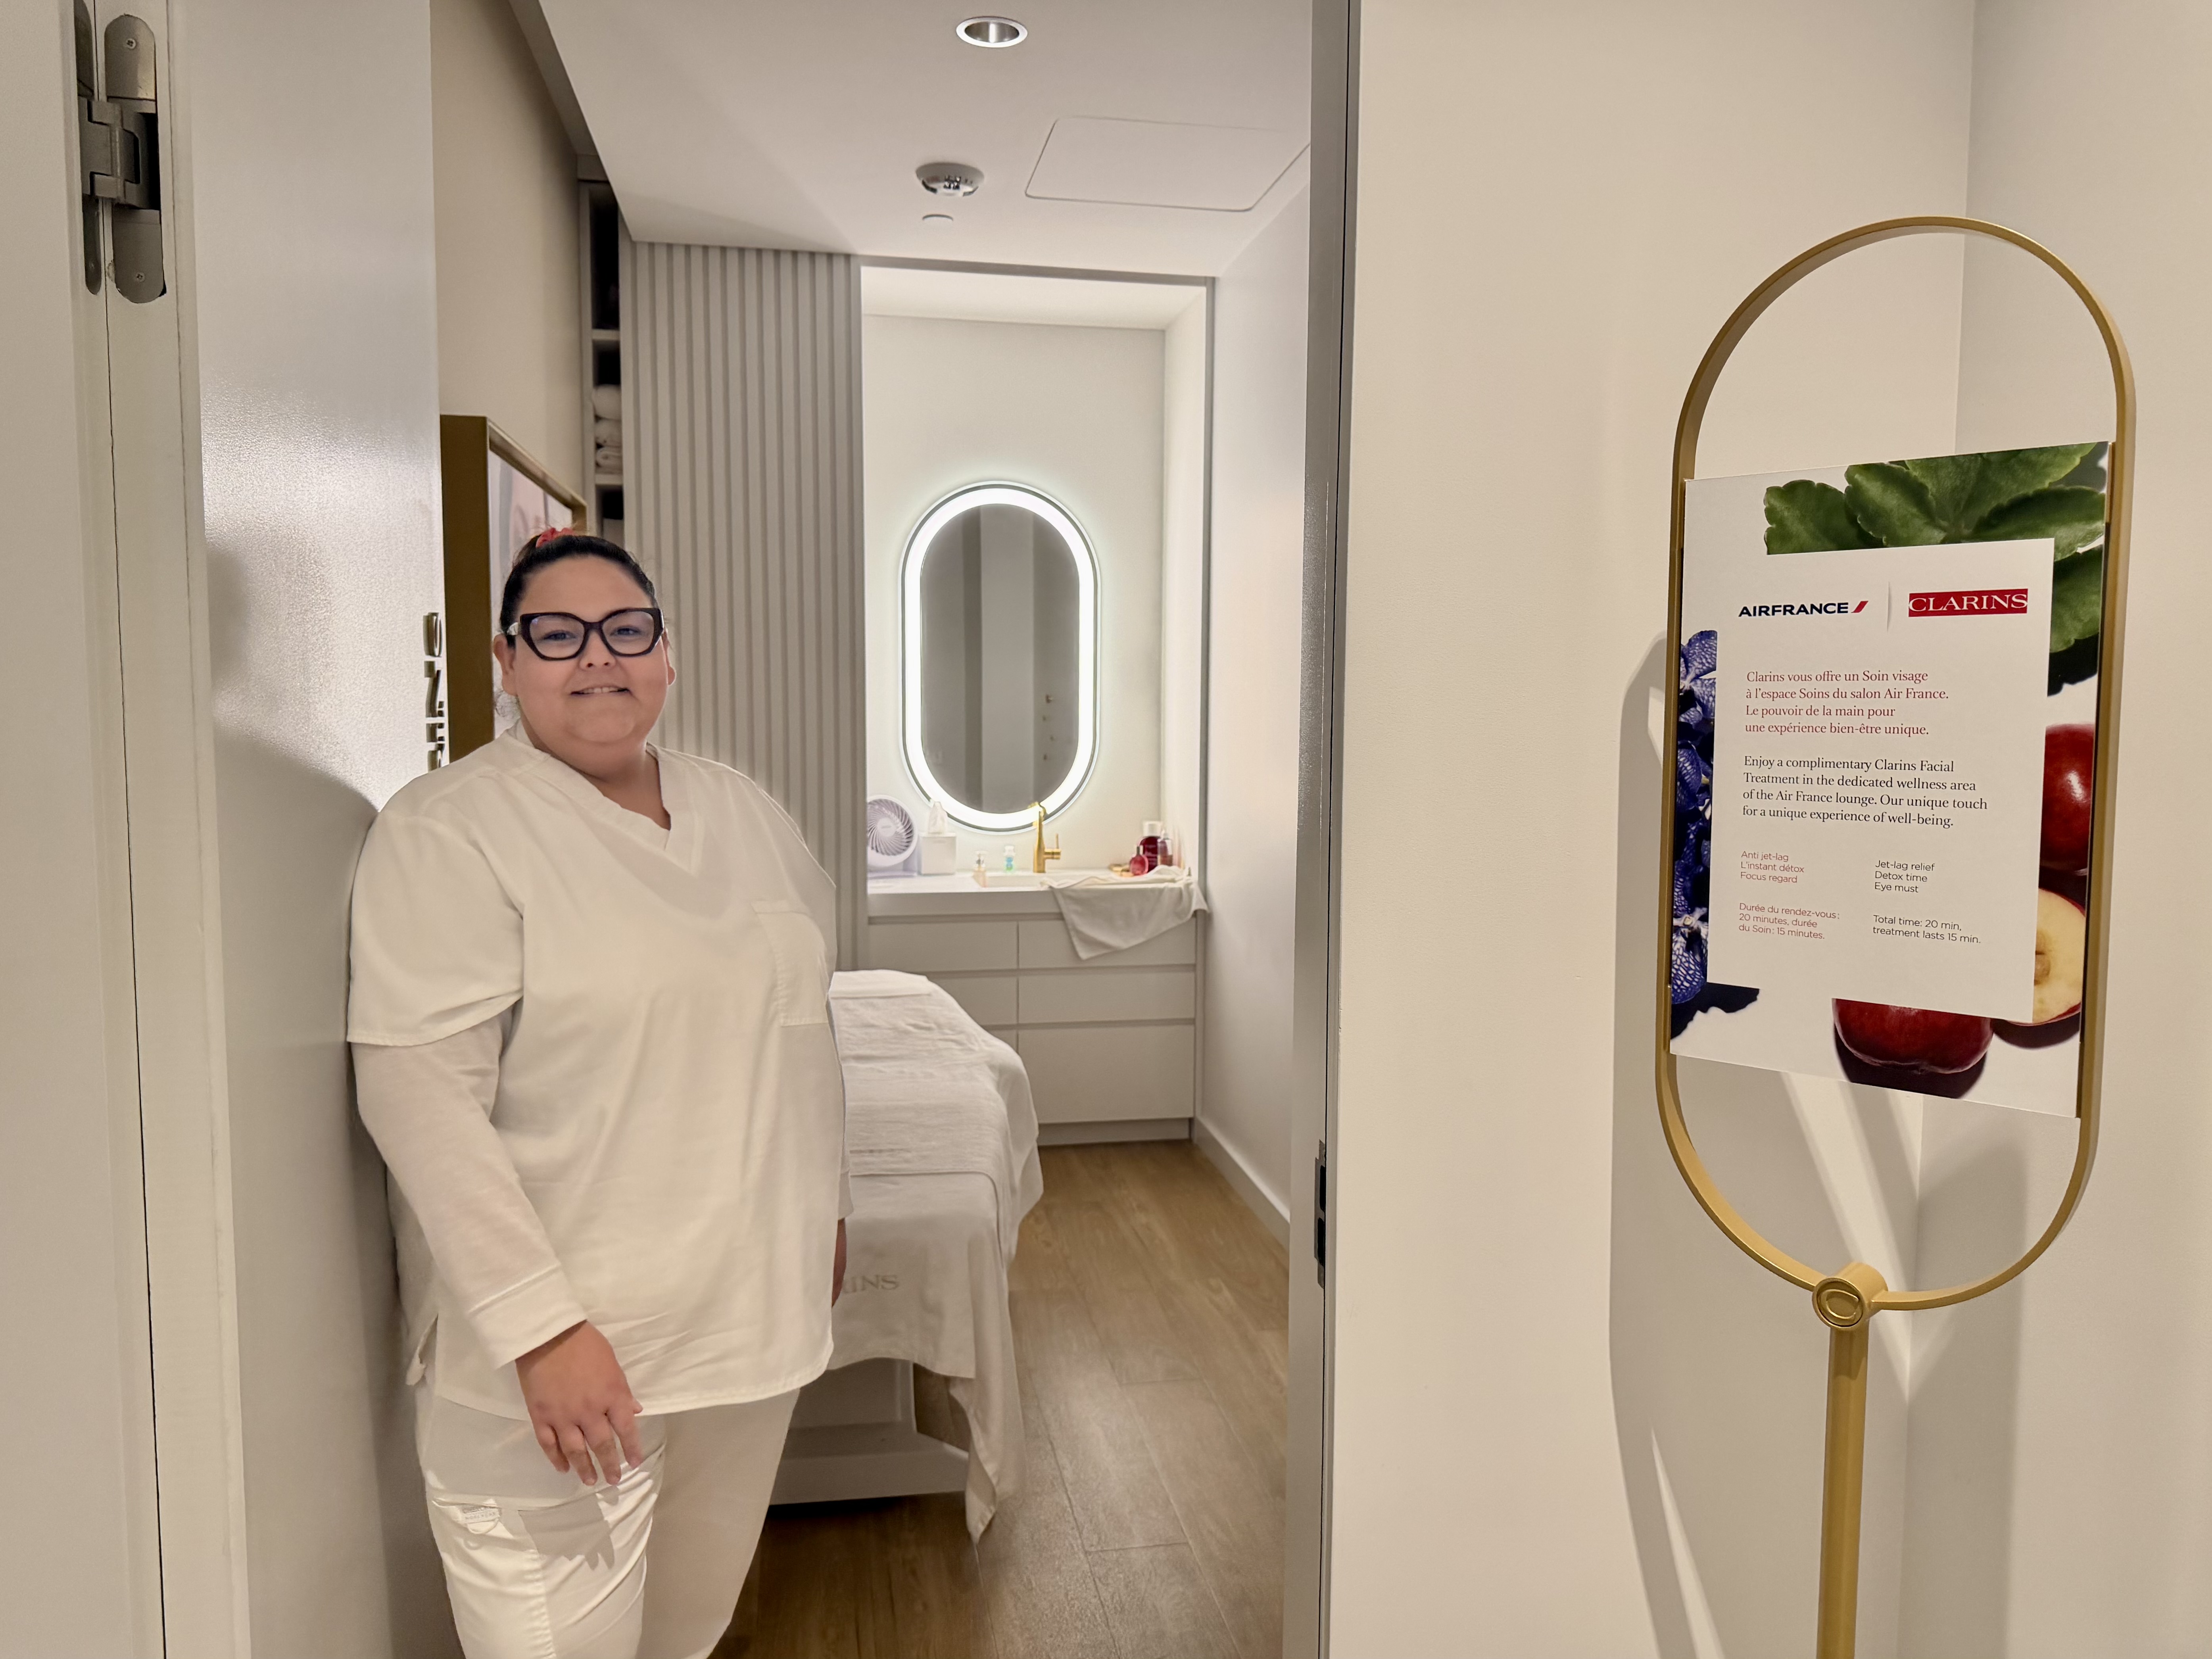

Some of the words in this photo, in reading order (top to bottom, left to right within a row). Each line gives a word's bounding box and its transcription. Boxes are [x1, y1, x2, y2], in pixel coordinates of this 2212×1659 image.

[1738, 602, 1849, 617] AIRFRANCE
[1909, 594, 2028, 611] CLARINS
[1747, 671, 1785, 682] Clarins
[1815, 670, 1841, 682] offre
[1862, 670, 1889, 681] Soin
[1892, 670, 1928, 684] visage
[1746, 688, 1752, 699] à
[1755, 688, 1797, 702] l'espace
[1799, 688, 1830, 699] Soins
[1832, 687, 1847, 699] du
[1850, 687, 1881, 699] salon
[1884, 687, 1903, 699] Air
[1905, 687, 1949, 699] France.
[1746, 705, 1759, 715] Le
[1761, 705, 1803, 718] pouvoir
[1805, 705, 1819, 716] de
[1822, 705, 1832, 716] la
[1835, 705, 1864, 716] main
[1867, 709, 1895, 719] pour
[1768, 722, 1827, 735] expérience
[1830, 722, 1881, 734] bien-être
[1885, 723, 1929, 737] unique.
[1744, 755, 1775, 770] Enjoy
[1786, 757, 1872, 773] complimentary
[1874, 759, 1916, 771] Clarins
[1920, 760, 1954, 772] Facial
[1743, 772, 1800, 784] Treatment
[1803, 774, 1813, 785] in
[1817, 774, 1835, 785] the
[1837, 775, 1893, 788] dedicated
[1896, 777, 1947, 790] wellness
[1950, 782, 1976, 791] area
[1743, 789, 1755, 799] of
[1756, 789, 1774, 800] the
[1775, 790, 1793, 801] Air
[1796, 791, 1833, 803] France
[1836, 792, 1878, 807] lounge.
[1880, 794, 1904, 806] Our
[1907, 795, 1949, 810] unique
[1953, 798, 1988, 810] touch
[1743, 805, 1758, 816] for
[1769, 807, 1807, 821] unique
[1810, 809, 1870, 822] experience
[1873, 811, 1887, 823] of
[1888, 812, 1954, 829] well-being.
[1741, 851, 1759, 859] Anti
[1761, 853, 1789, 862] jet-lag
[1741, 861, 1777, 871] L'instant
[1779, 864, 1804, 873] détox
[1875, 860, 1908, 871] Jet-lag
[1911, 862, 1935, 871] relief
[1740, 872, 1766, 881] Focus
[1769, 875, 1797, 883] regard
[1875, 871, 1903, 881] Detox
[1906, 873, 1928, 882] time
[1874, 881, 1892, 892] Eye
[1740, 902, 1765, 912] Durée
[1739, 913, 1751, 921] 20
[1753, 916, 1789, 926] minutes,
[1791, 918, 1818, 928] durée
[1873, 914, 1896, 925] Total
[1899, 917, 1922, 927] time:
[1925, 919, 1938, 928] 20
[1941, 922, 1962, 931] min,
[1788, 929, 1825, 939] minutes.
[1873, 926, 1920, 938] treatment
[1923, 930, 1945, 940] lasts
[1947, 933, 1957, 941] 15
[1960, 935, 1981, 943] min.
